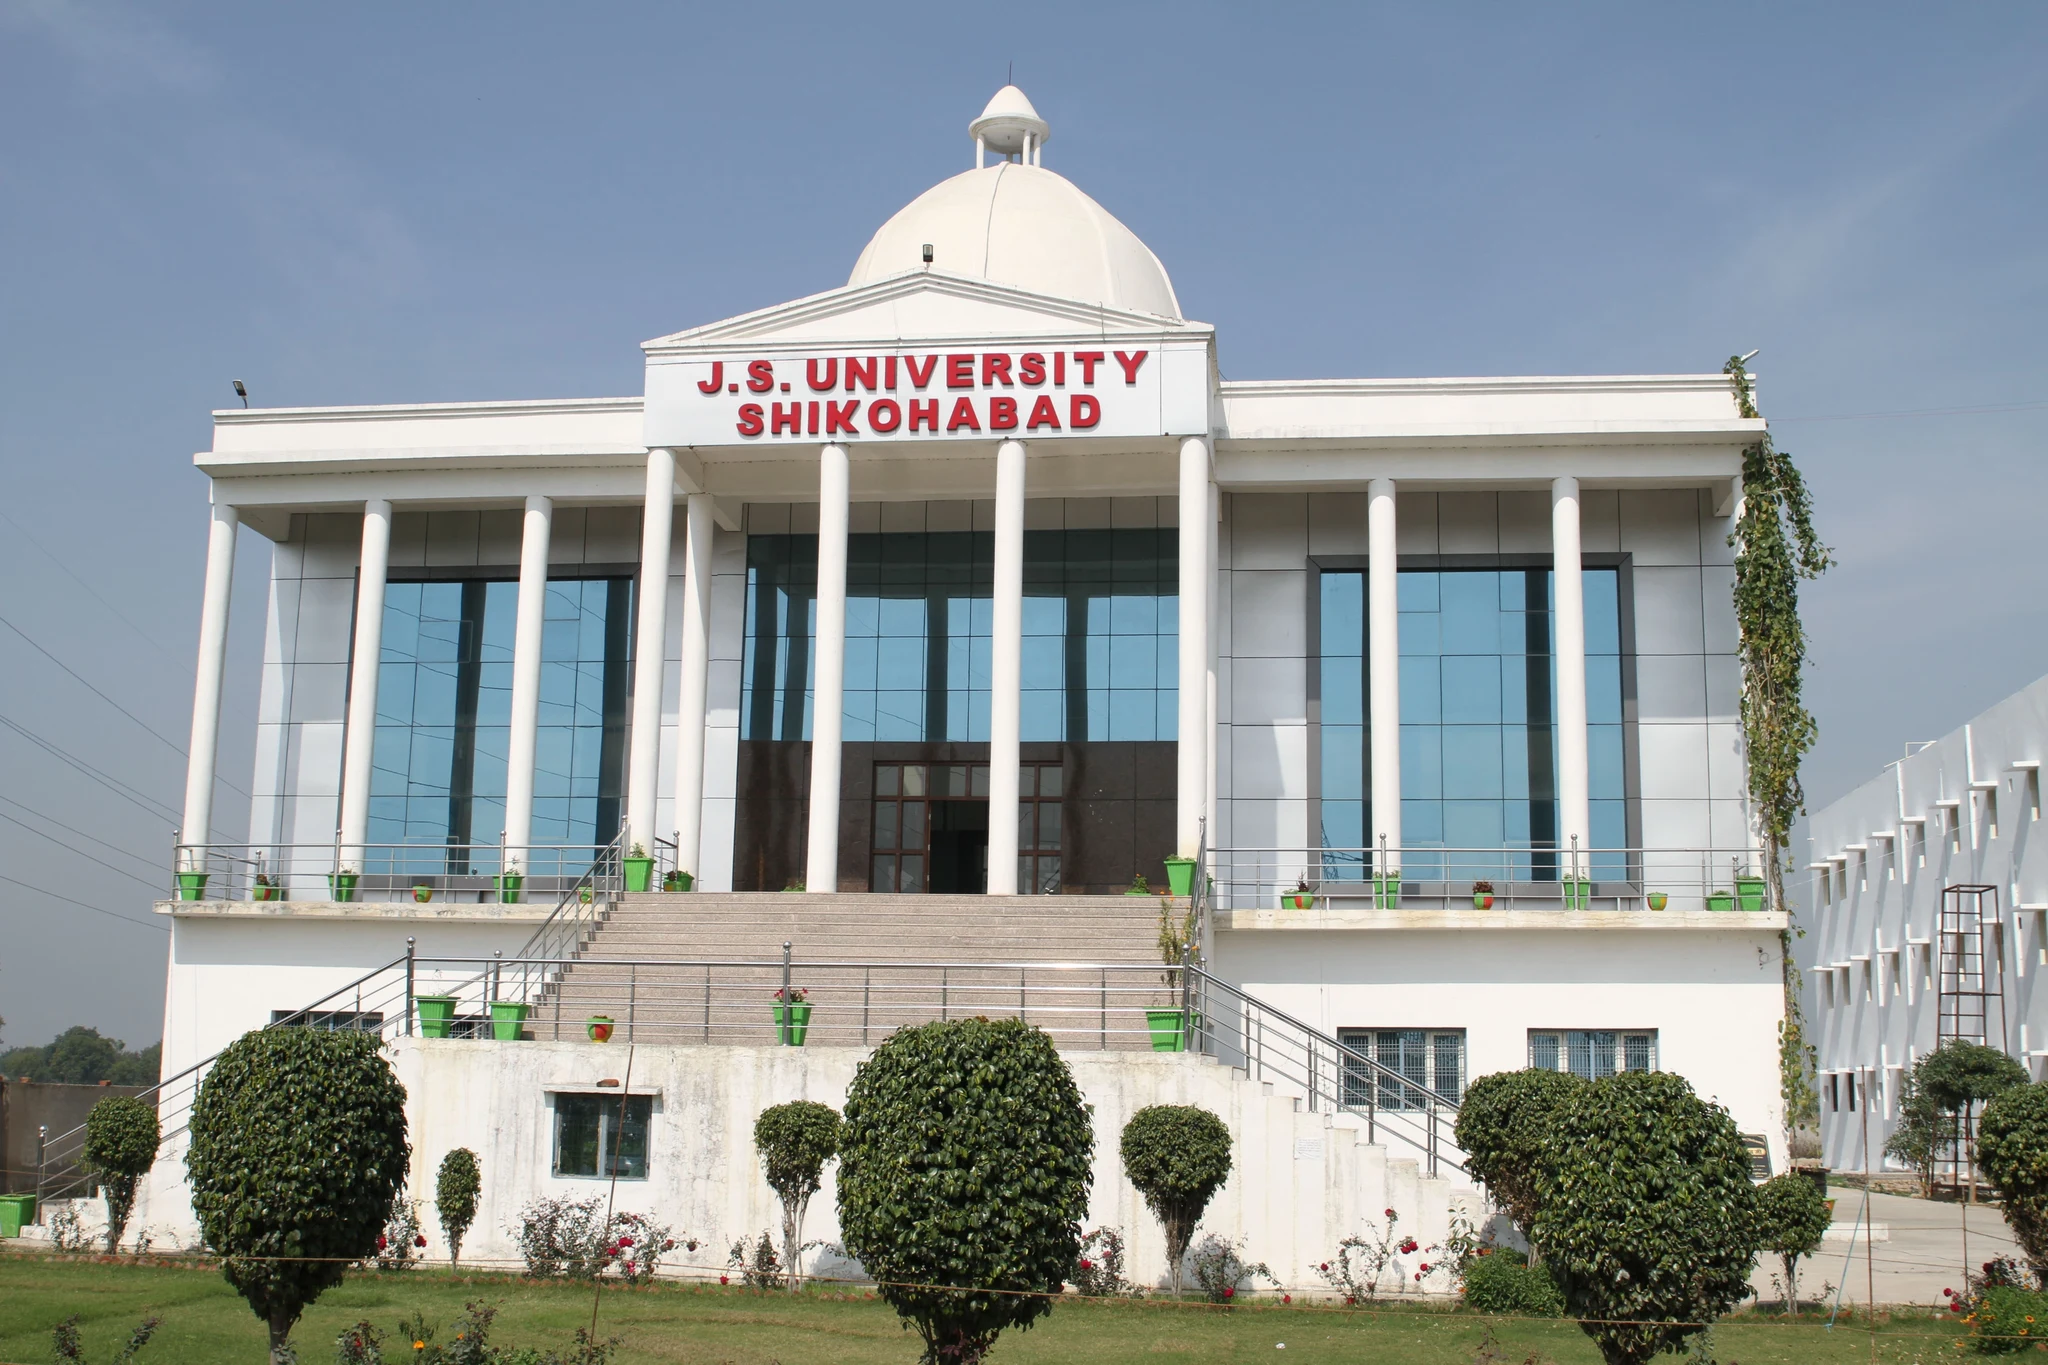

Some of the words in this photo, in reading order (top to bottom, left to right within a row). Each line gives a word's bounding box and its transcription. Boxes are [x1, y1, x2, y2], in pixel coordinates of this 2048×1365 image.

[697, 360, 790, 393] J.S.
[806, 351, 1147, 390] UNIVERSITY
[737, 395, 1101, 435] SHIKOHABAD
